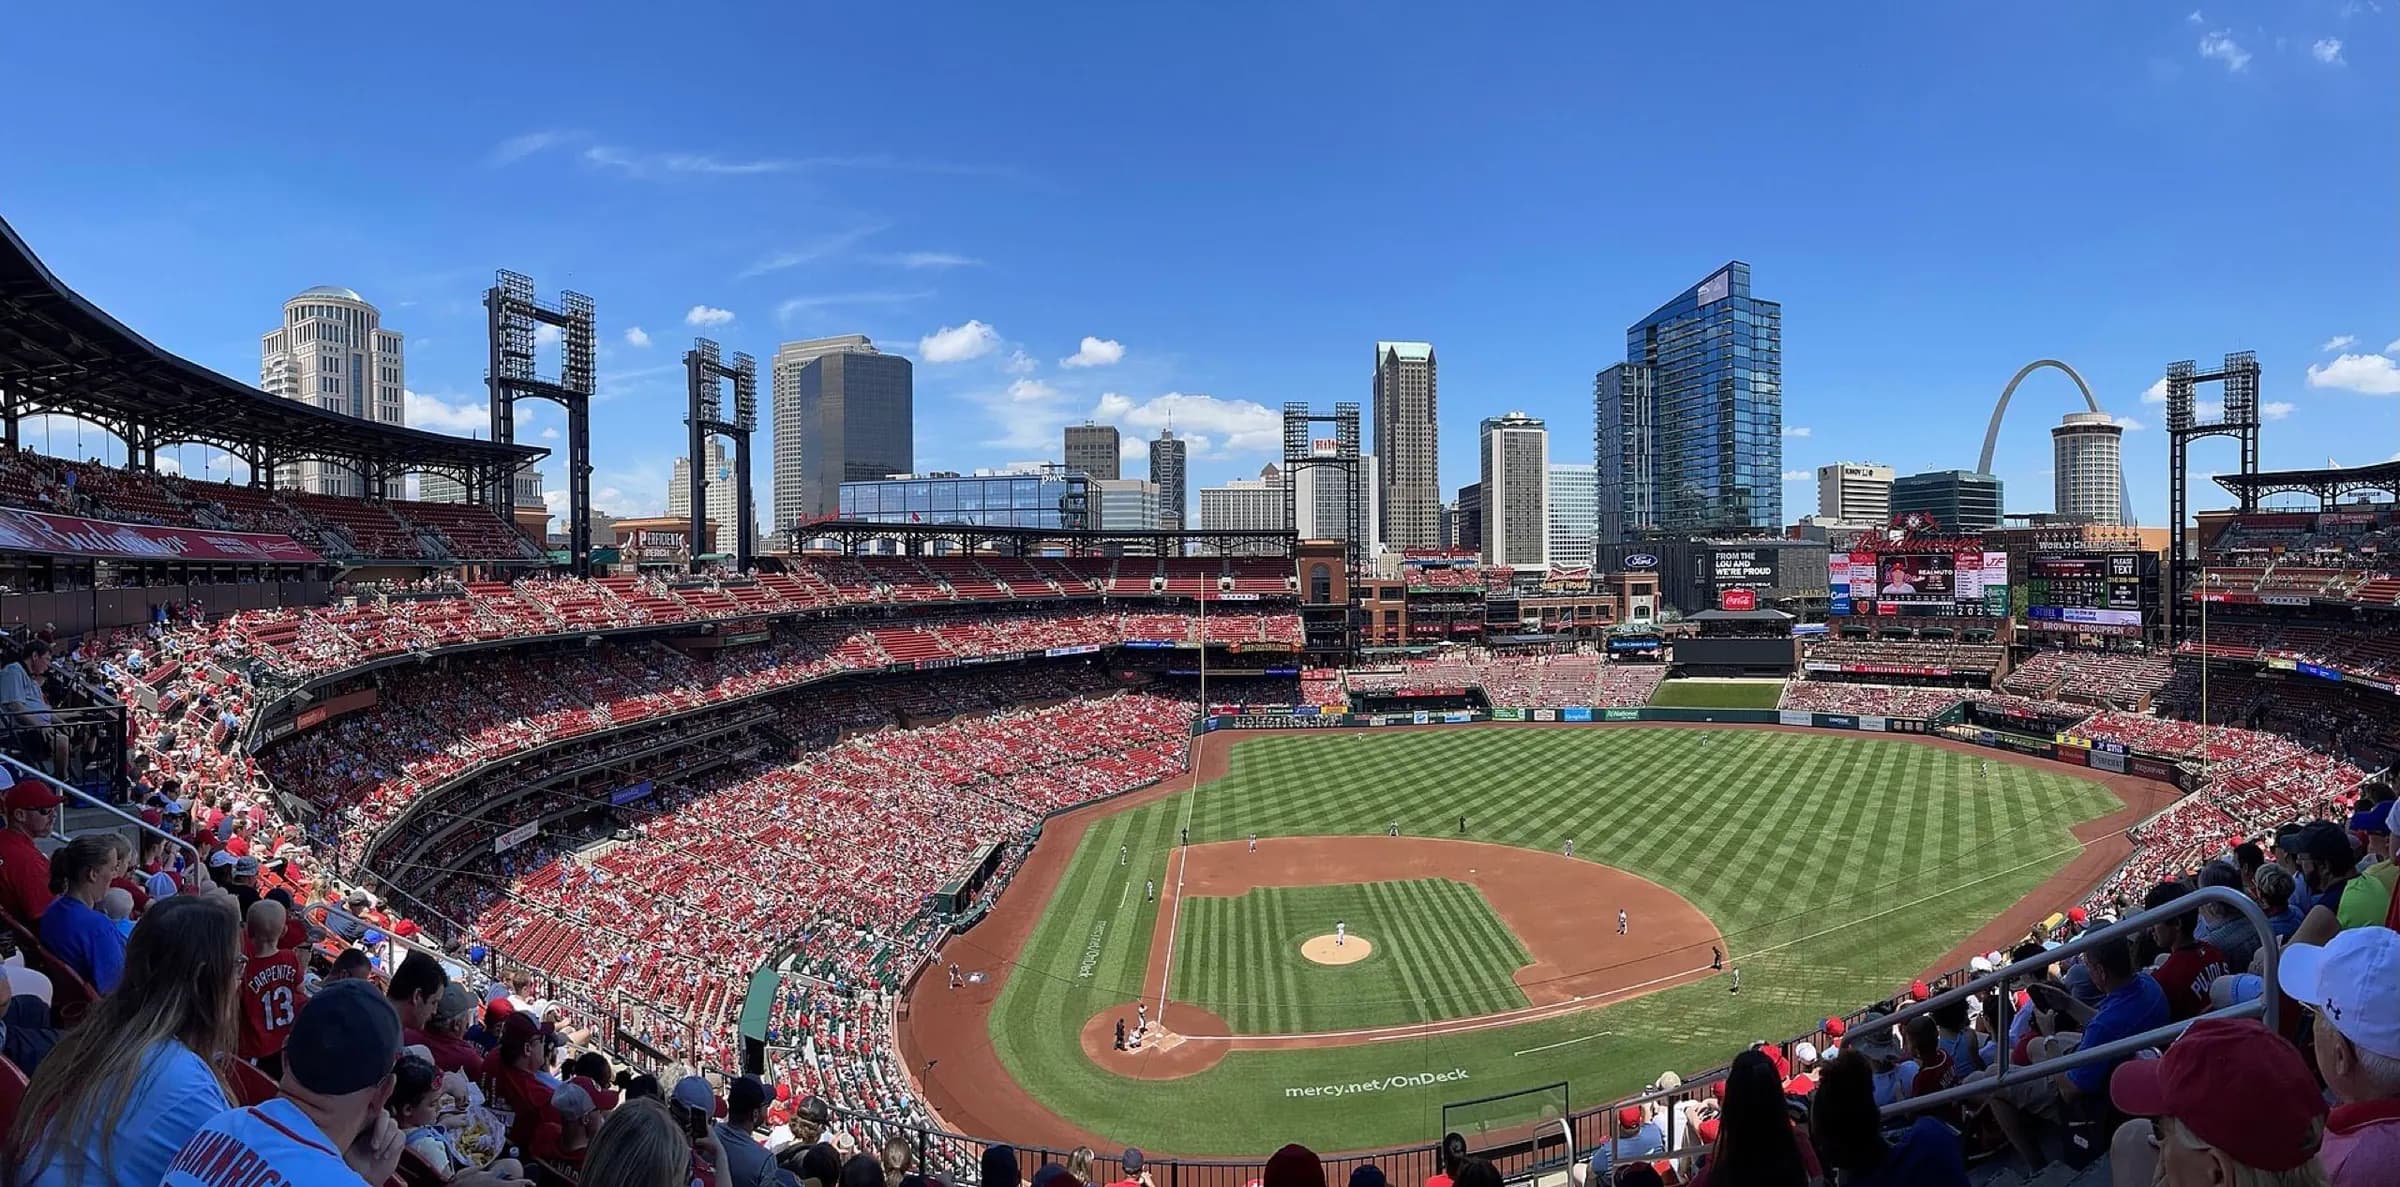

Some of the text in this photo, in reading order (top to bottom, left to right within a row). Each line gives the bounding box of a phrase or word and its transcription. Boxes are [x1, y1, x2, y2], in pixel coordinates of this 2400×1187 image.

[1041, 472, 1065, 486] pwc
[2039, 540, 2130, 550] WORLD CHAMPIONS
[644, 549, 670, 557] PERCH
[1715, 552, 1756, 560] FROM THE
[1631, 555, 1652, 565] Ford
[1715, 560, 1751, 568] LOU AND
[1715, 567, 1772, 575] WE'RE PROUD
[2113, 565, 2133, 575] TEXT
[1565, 580, 1591, 589] HOUSE
[1957, 607, 1983, 615] 2 0 2
[2043, 622, 2072, 632] BROWN
[2079, 624, 2124, 635] CROUPPEN
[2190, 962, 2230, 1000] PUJOLS
[261, 986, 294, 1030] 13
[1285, 1068, 1470, 1097] mercy.net/OnDeck
[167, 1129, 292, 1187] AINWRIG
